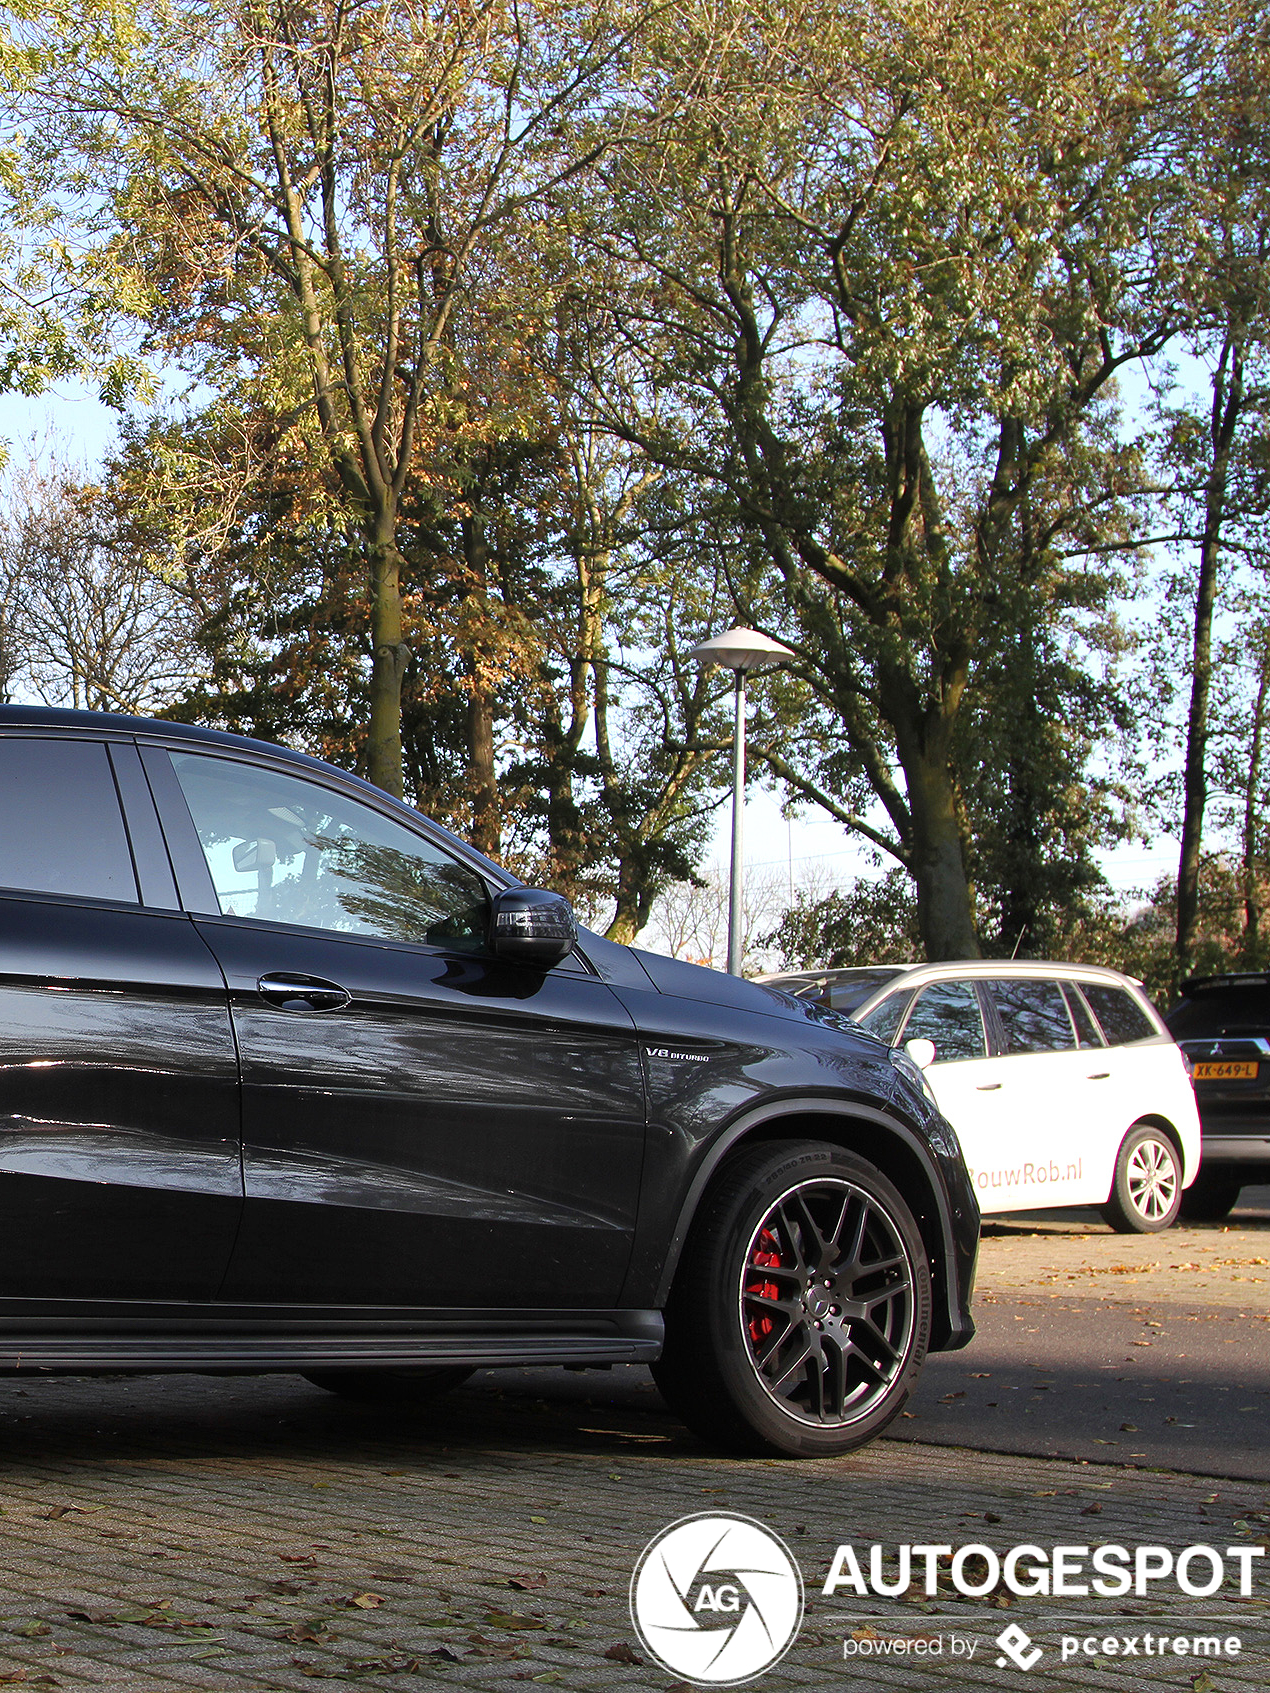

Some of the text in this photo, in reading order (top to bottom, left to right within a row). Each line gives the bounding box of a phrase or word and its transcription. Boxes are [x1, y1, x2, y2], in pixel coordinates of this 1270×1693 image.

[645, 1047, 711, 1063] V8 BITURBO
[1196, 1064, 1252, 1077] XK-649-L
[765, 1153, 827, 1185] 285/40 ZR 22
[912, 1264, 931, 1367] Continental
